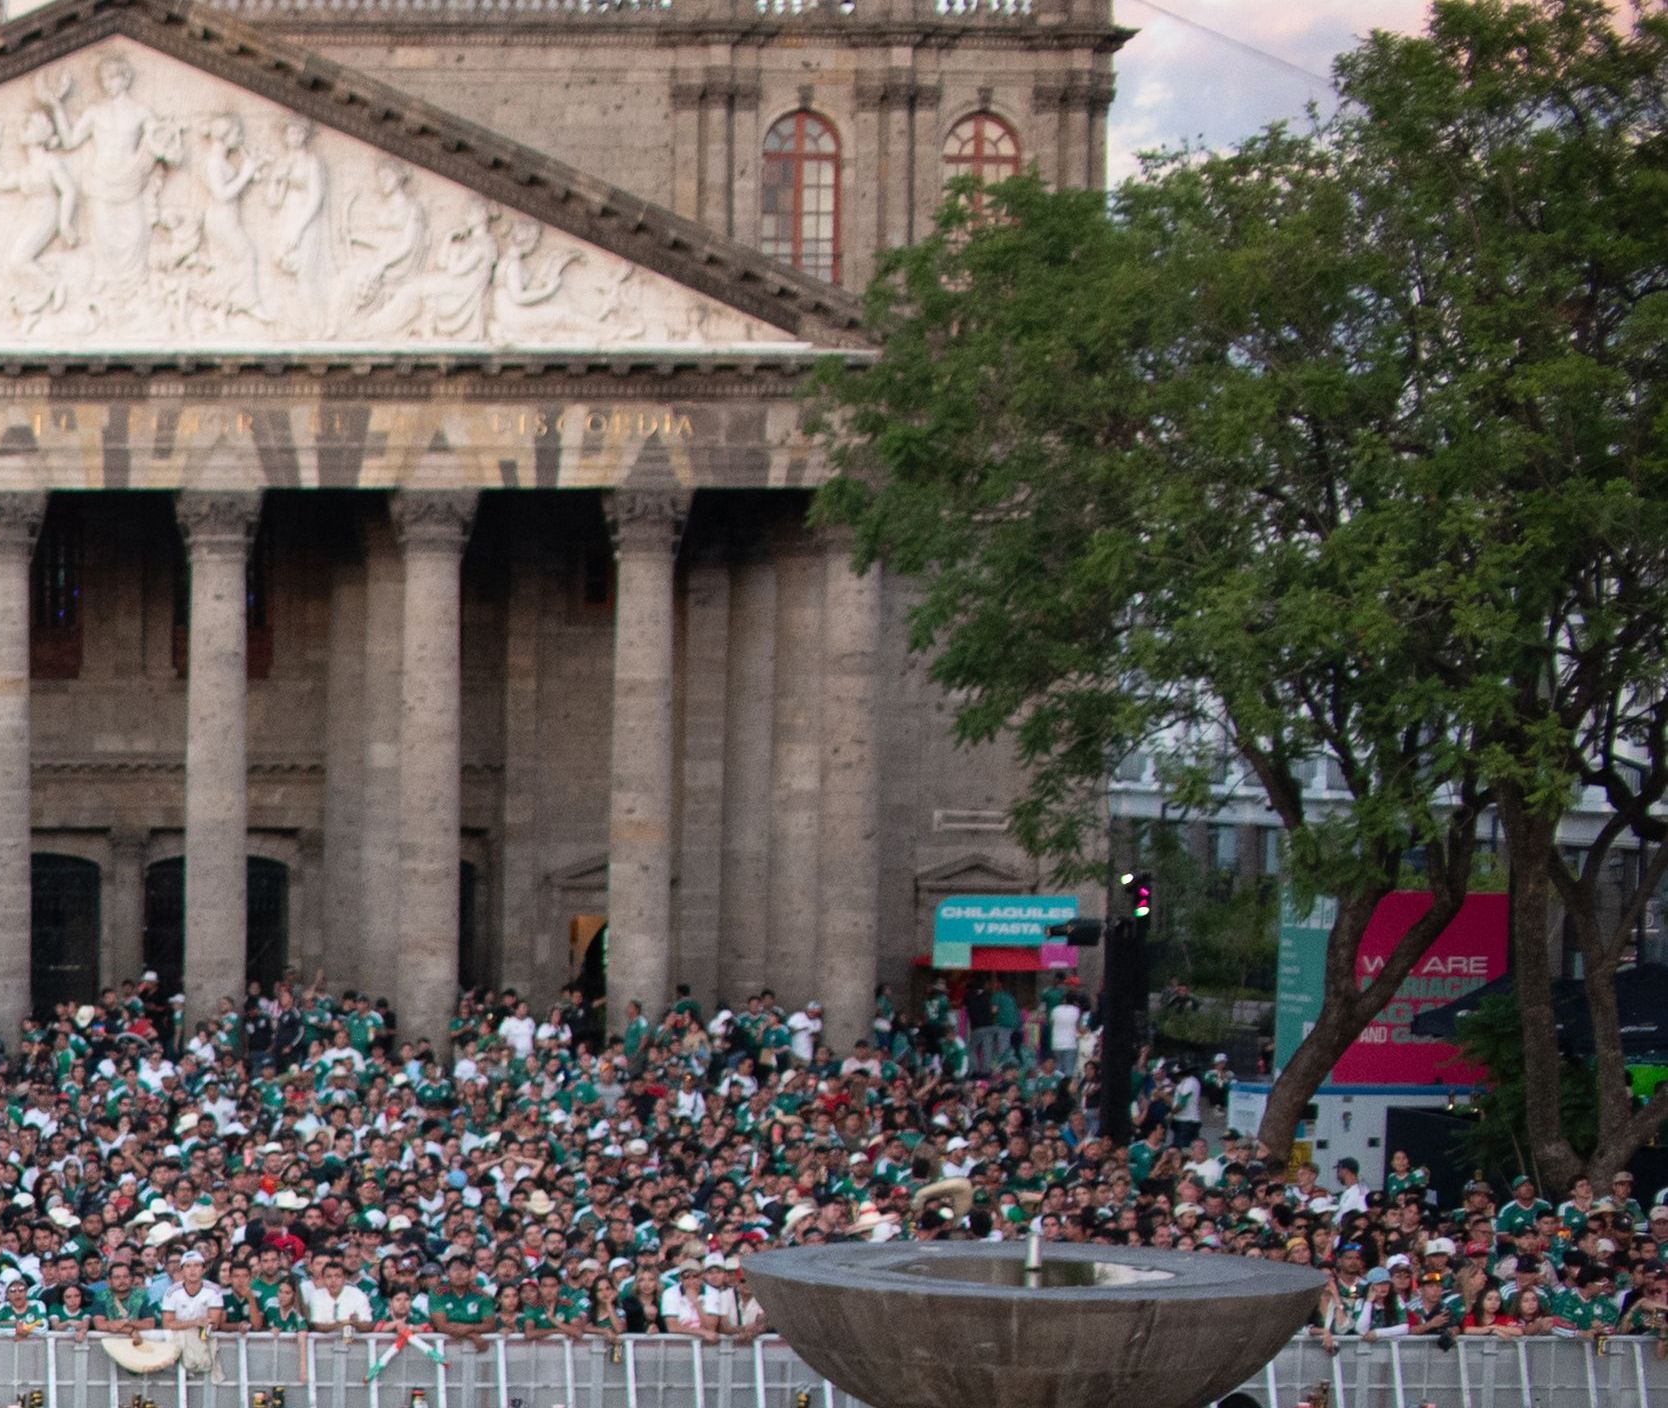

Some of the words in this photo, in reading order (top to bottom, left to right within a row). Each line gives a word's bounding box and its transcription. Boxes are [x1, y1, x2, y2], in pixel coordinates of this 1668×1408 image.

[941, 906, 1075, 919] CHILAQUILES
[986, 923, 1042, 935] PASTA
[1422, 956, 1489, 974] ARE
